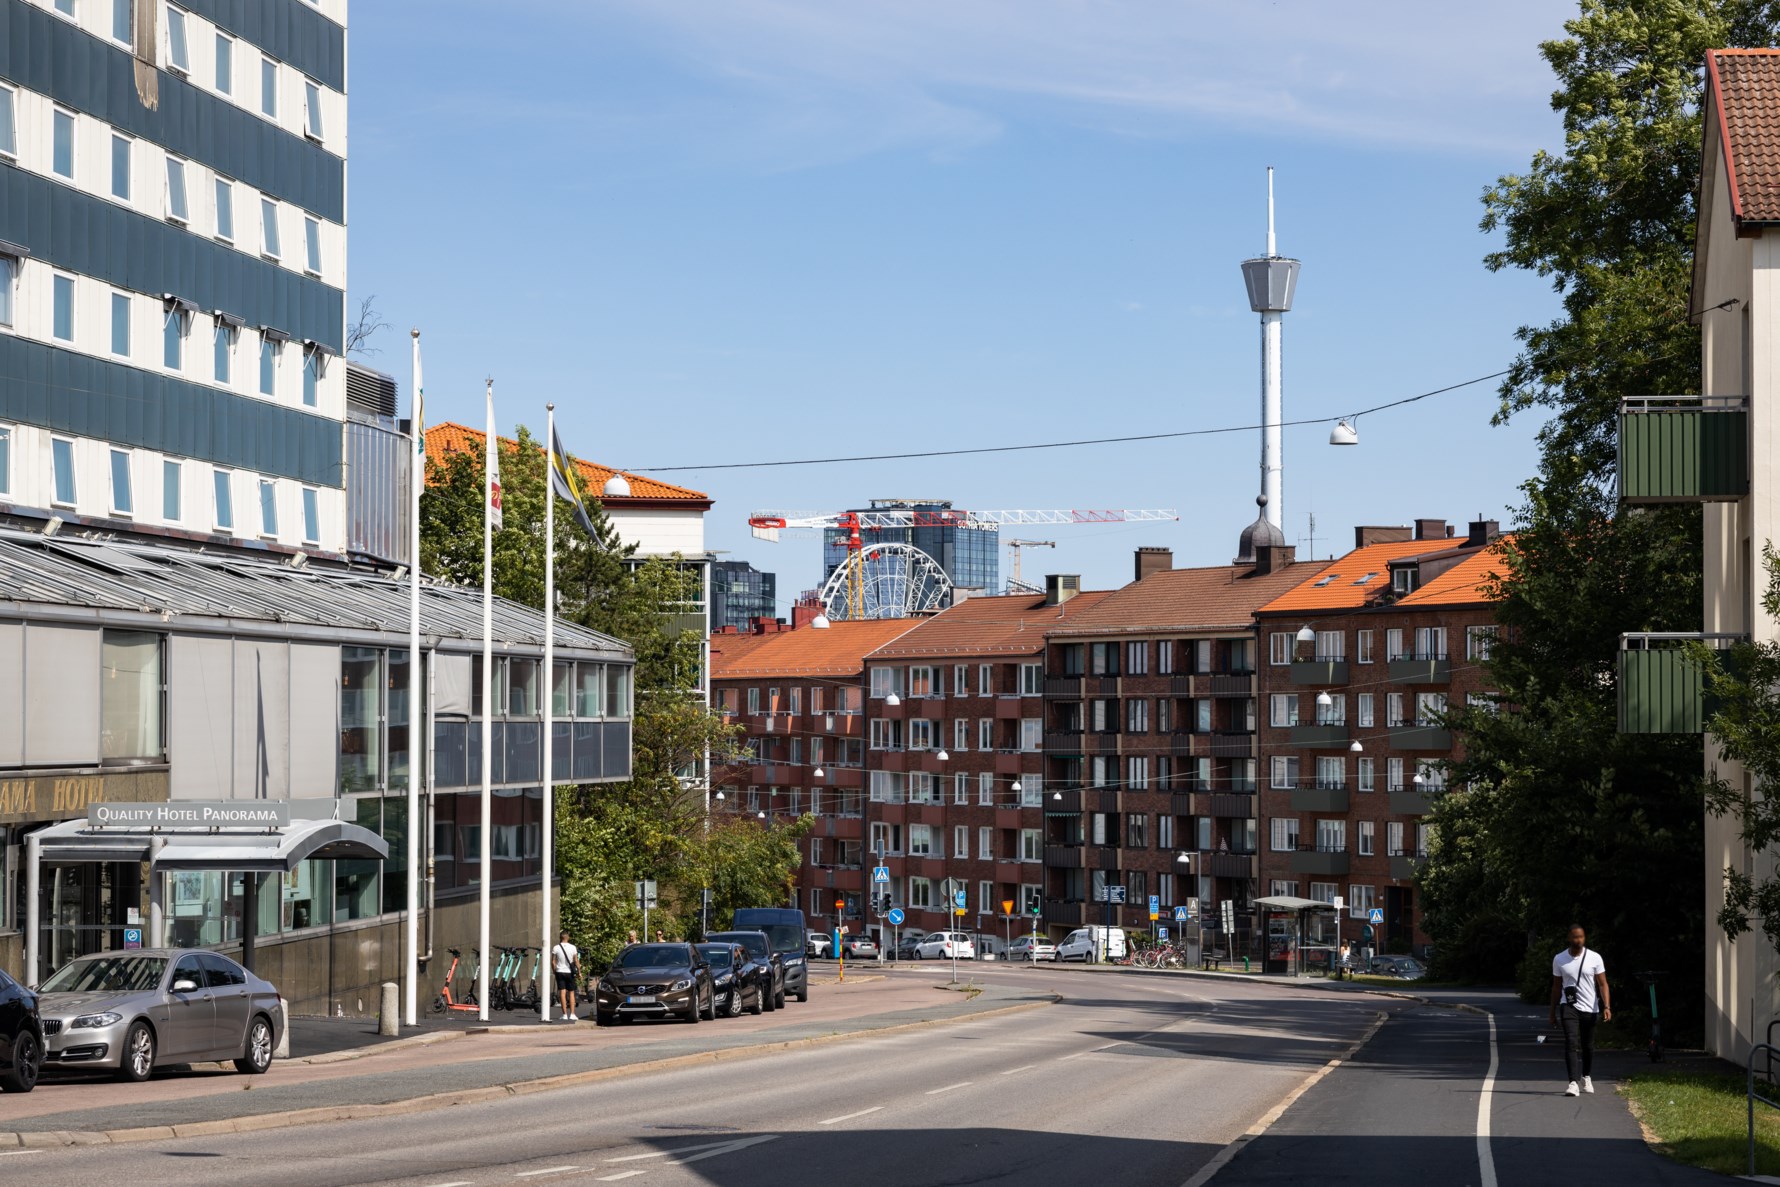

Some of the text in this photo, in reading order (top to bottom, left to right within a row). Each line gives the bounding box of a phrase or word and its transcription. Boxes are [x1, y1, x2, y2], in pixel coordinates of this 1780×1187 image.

[53, 778, 107, 811] HOTEL
[97, 807, 278, 822] QUALITY HOTEL PANORAMA
[1190, 900, 1197, 909] A
